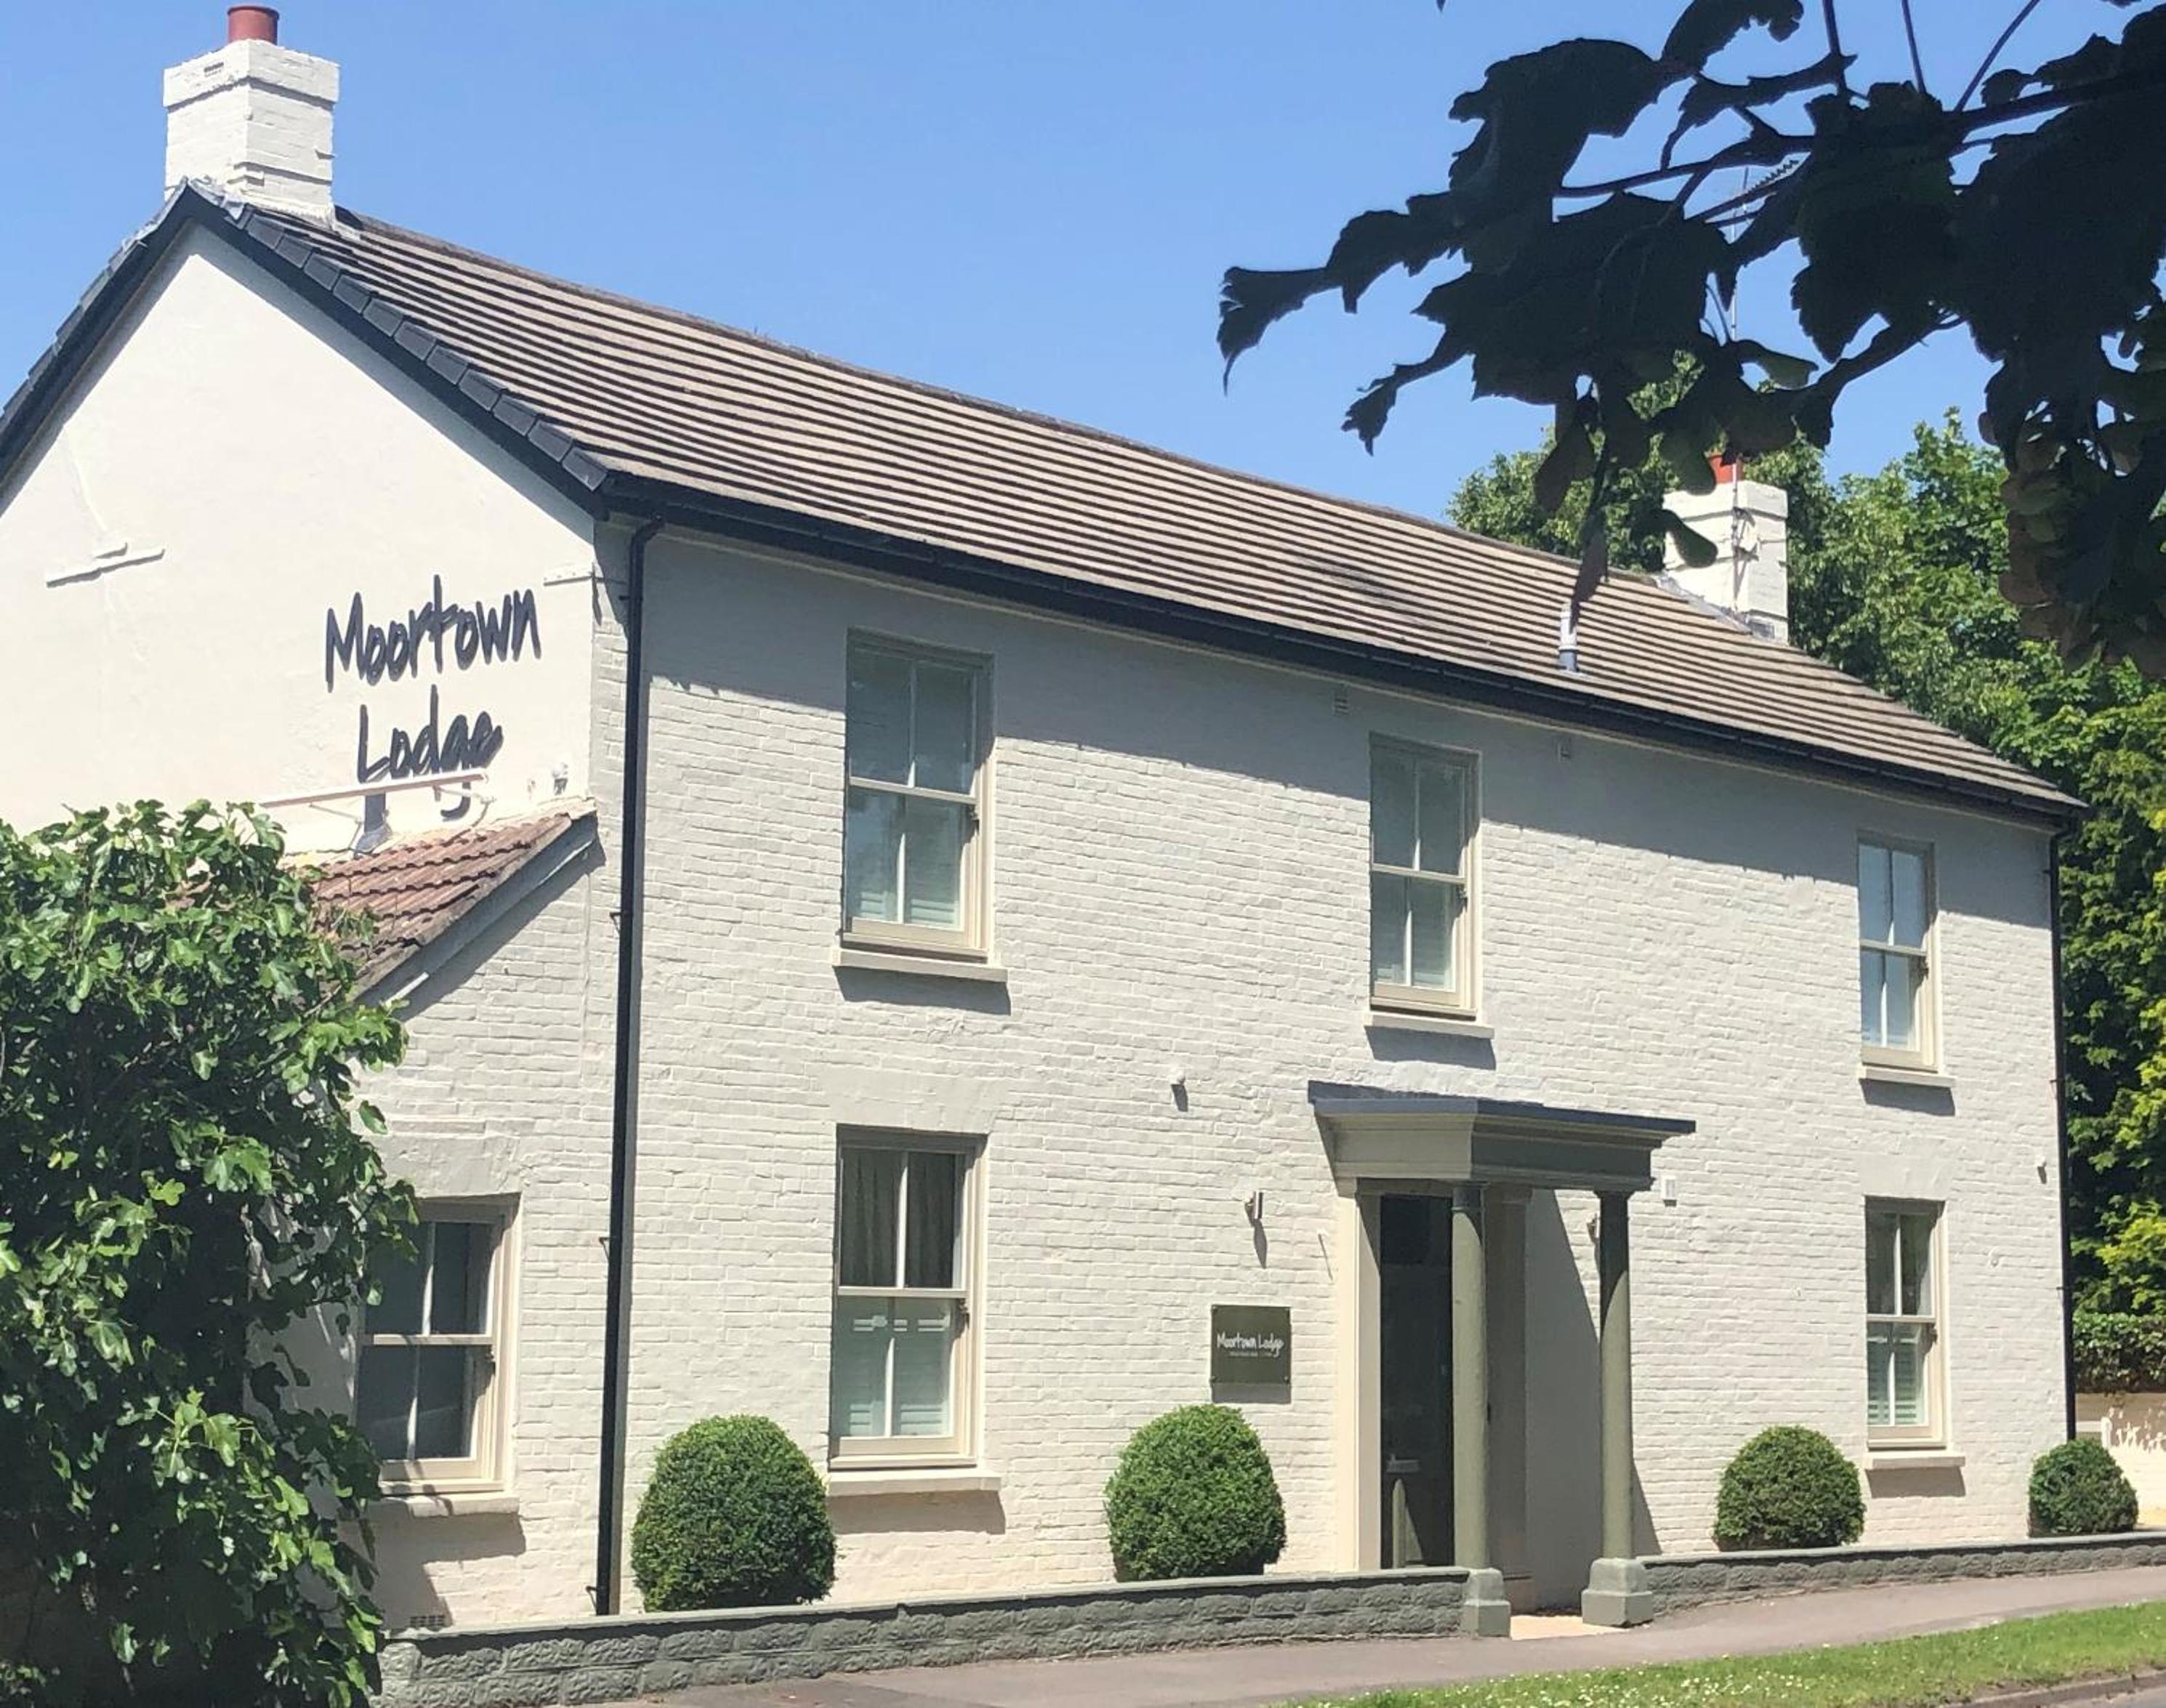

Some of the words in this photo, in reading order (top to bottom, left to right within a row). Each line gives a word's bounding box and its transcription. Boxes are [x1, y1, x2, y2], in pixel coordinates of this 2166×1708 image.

[326, 574, 542, 693] Moortown
[357, 684, 503, 822] Lodge
[1258, 1332, 1284, 1358] Lodge
